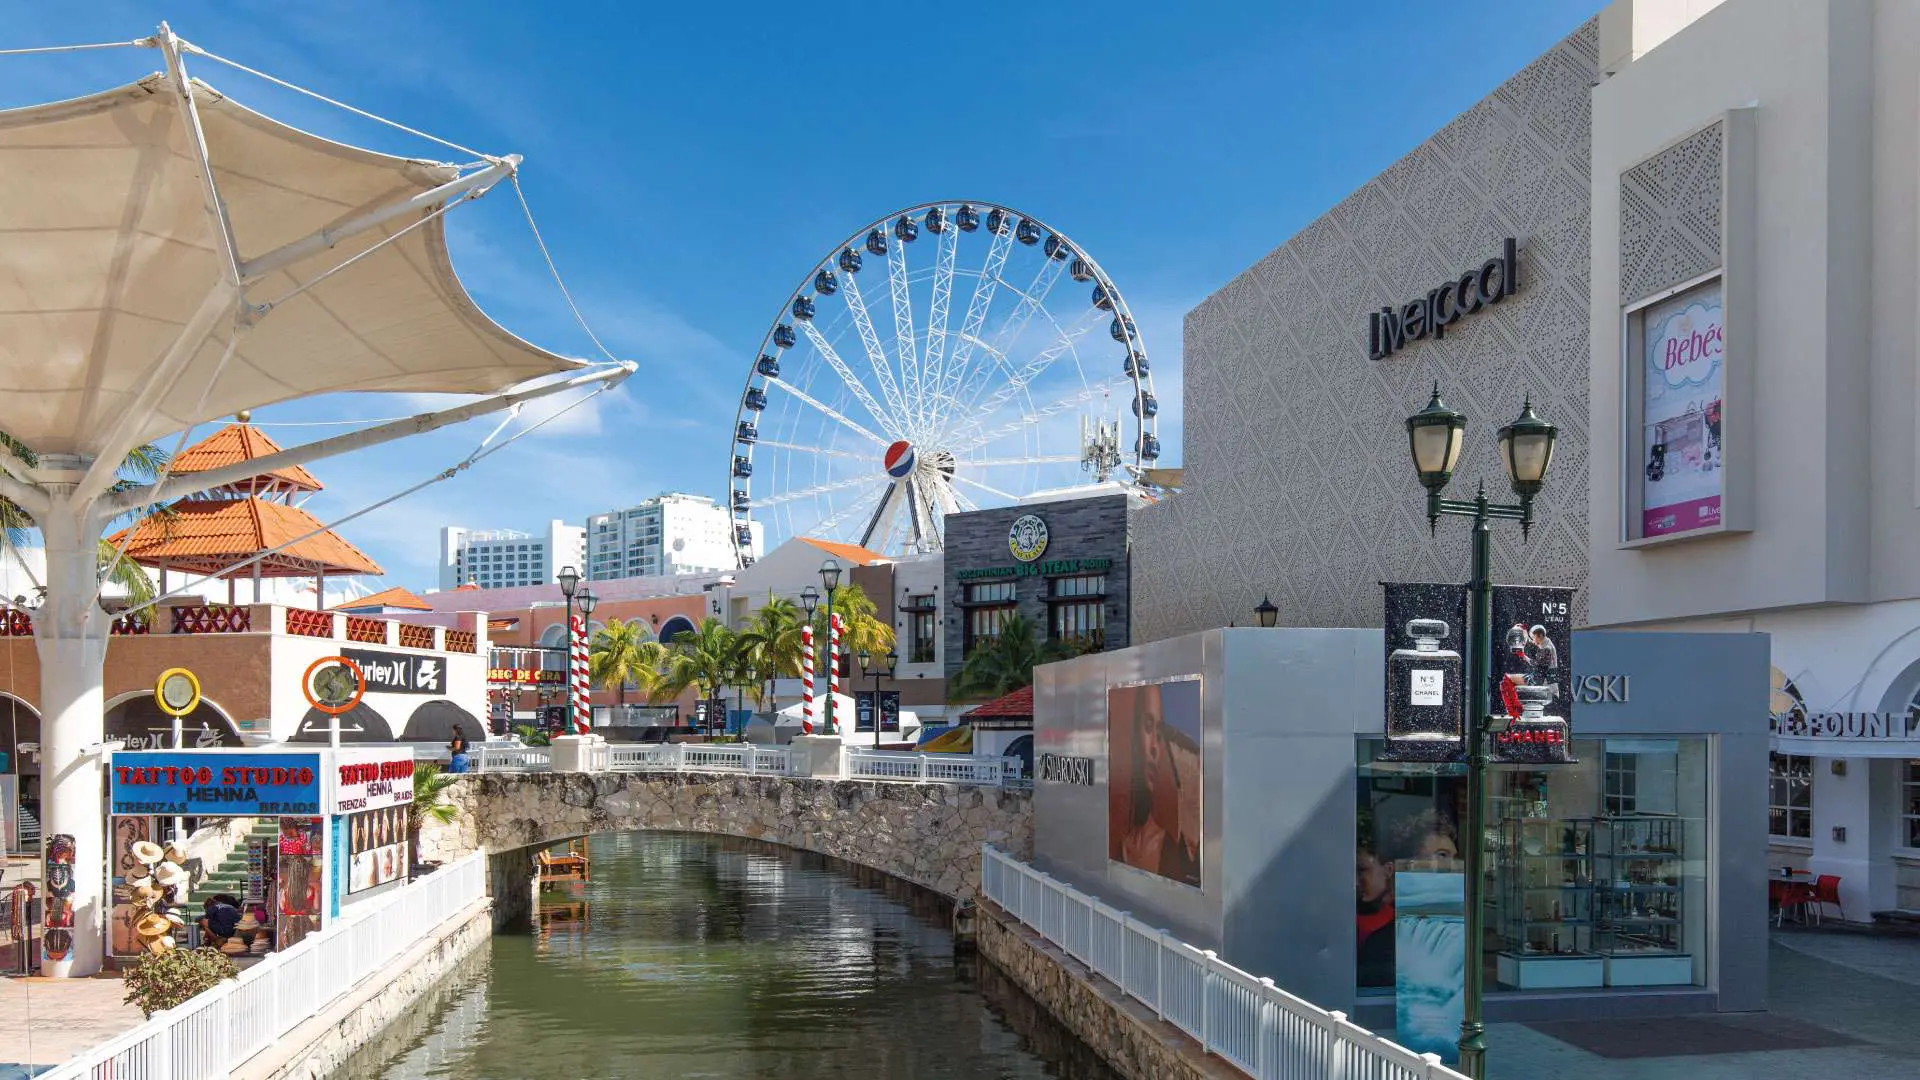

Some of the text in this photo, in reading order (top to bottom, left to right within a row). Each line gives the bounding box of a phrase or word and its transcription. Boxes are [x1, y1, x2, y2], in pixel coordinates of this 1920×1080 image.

[1369, 238, 1516, 361] Liverpool
[1014, 562, 1038, 576] BIG
[1041, 560, 1080, 575] STEAK
[516, 669, 531, 680] DE
[1571, 675, 1631, 703] VSKI
[1498, 729, 1564, 744] CHANEL
[115, 766, 315, 785] TATTOO STUDIO
[339, 760, 414, 786] TATTOO STUDIO
[1046, 755, 1089, 786] SWAROVSKI
[186, 787, 259, 802] HENNA
[366, 781, 393, 798] HENNA
[114, 801, 319, 813] TRENZAS BRAIDS
[338, 790, 413, 811] TRENZAS BRAIDS
